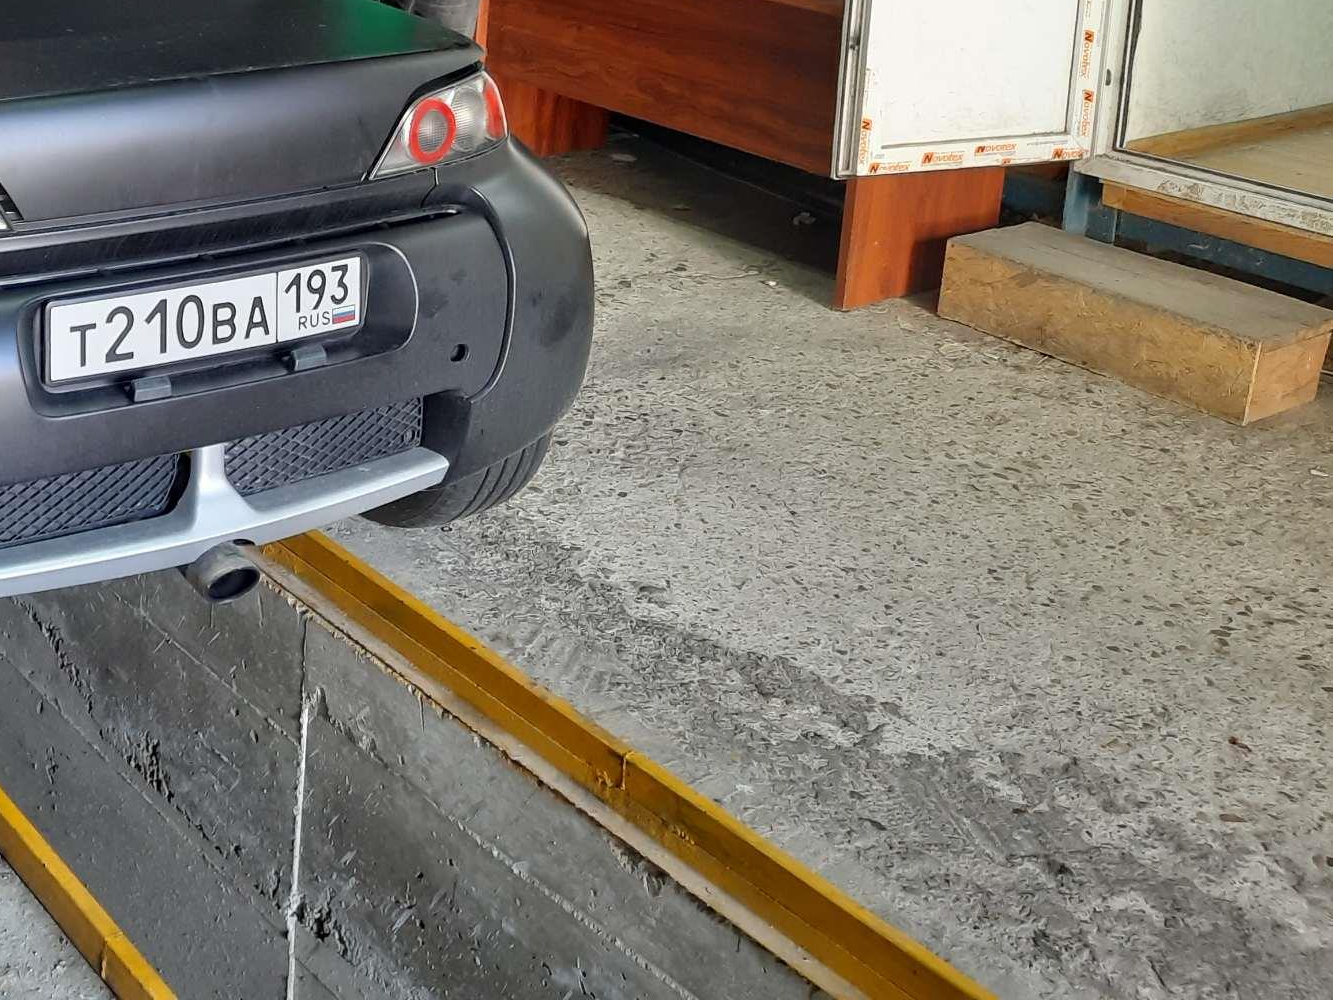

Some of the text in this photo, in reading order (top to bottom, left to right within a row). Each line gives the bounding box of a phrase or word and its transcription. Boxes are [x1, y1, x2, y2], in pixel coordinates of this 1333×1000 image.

[1080, 29, 1095, 78] Novotex
[859, 118, 873, 166] Novotex
[921, 152, 965, 166] Novotex
[974, 143, 1018, 156] Novotex
[284, 263, 349, 313] 193
[298, 310, 331, 331] RUS
